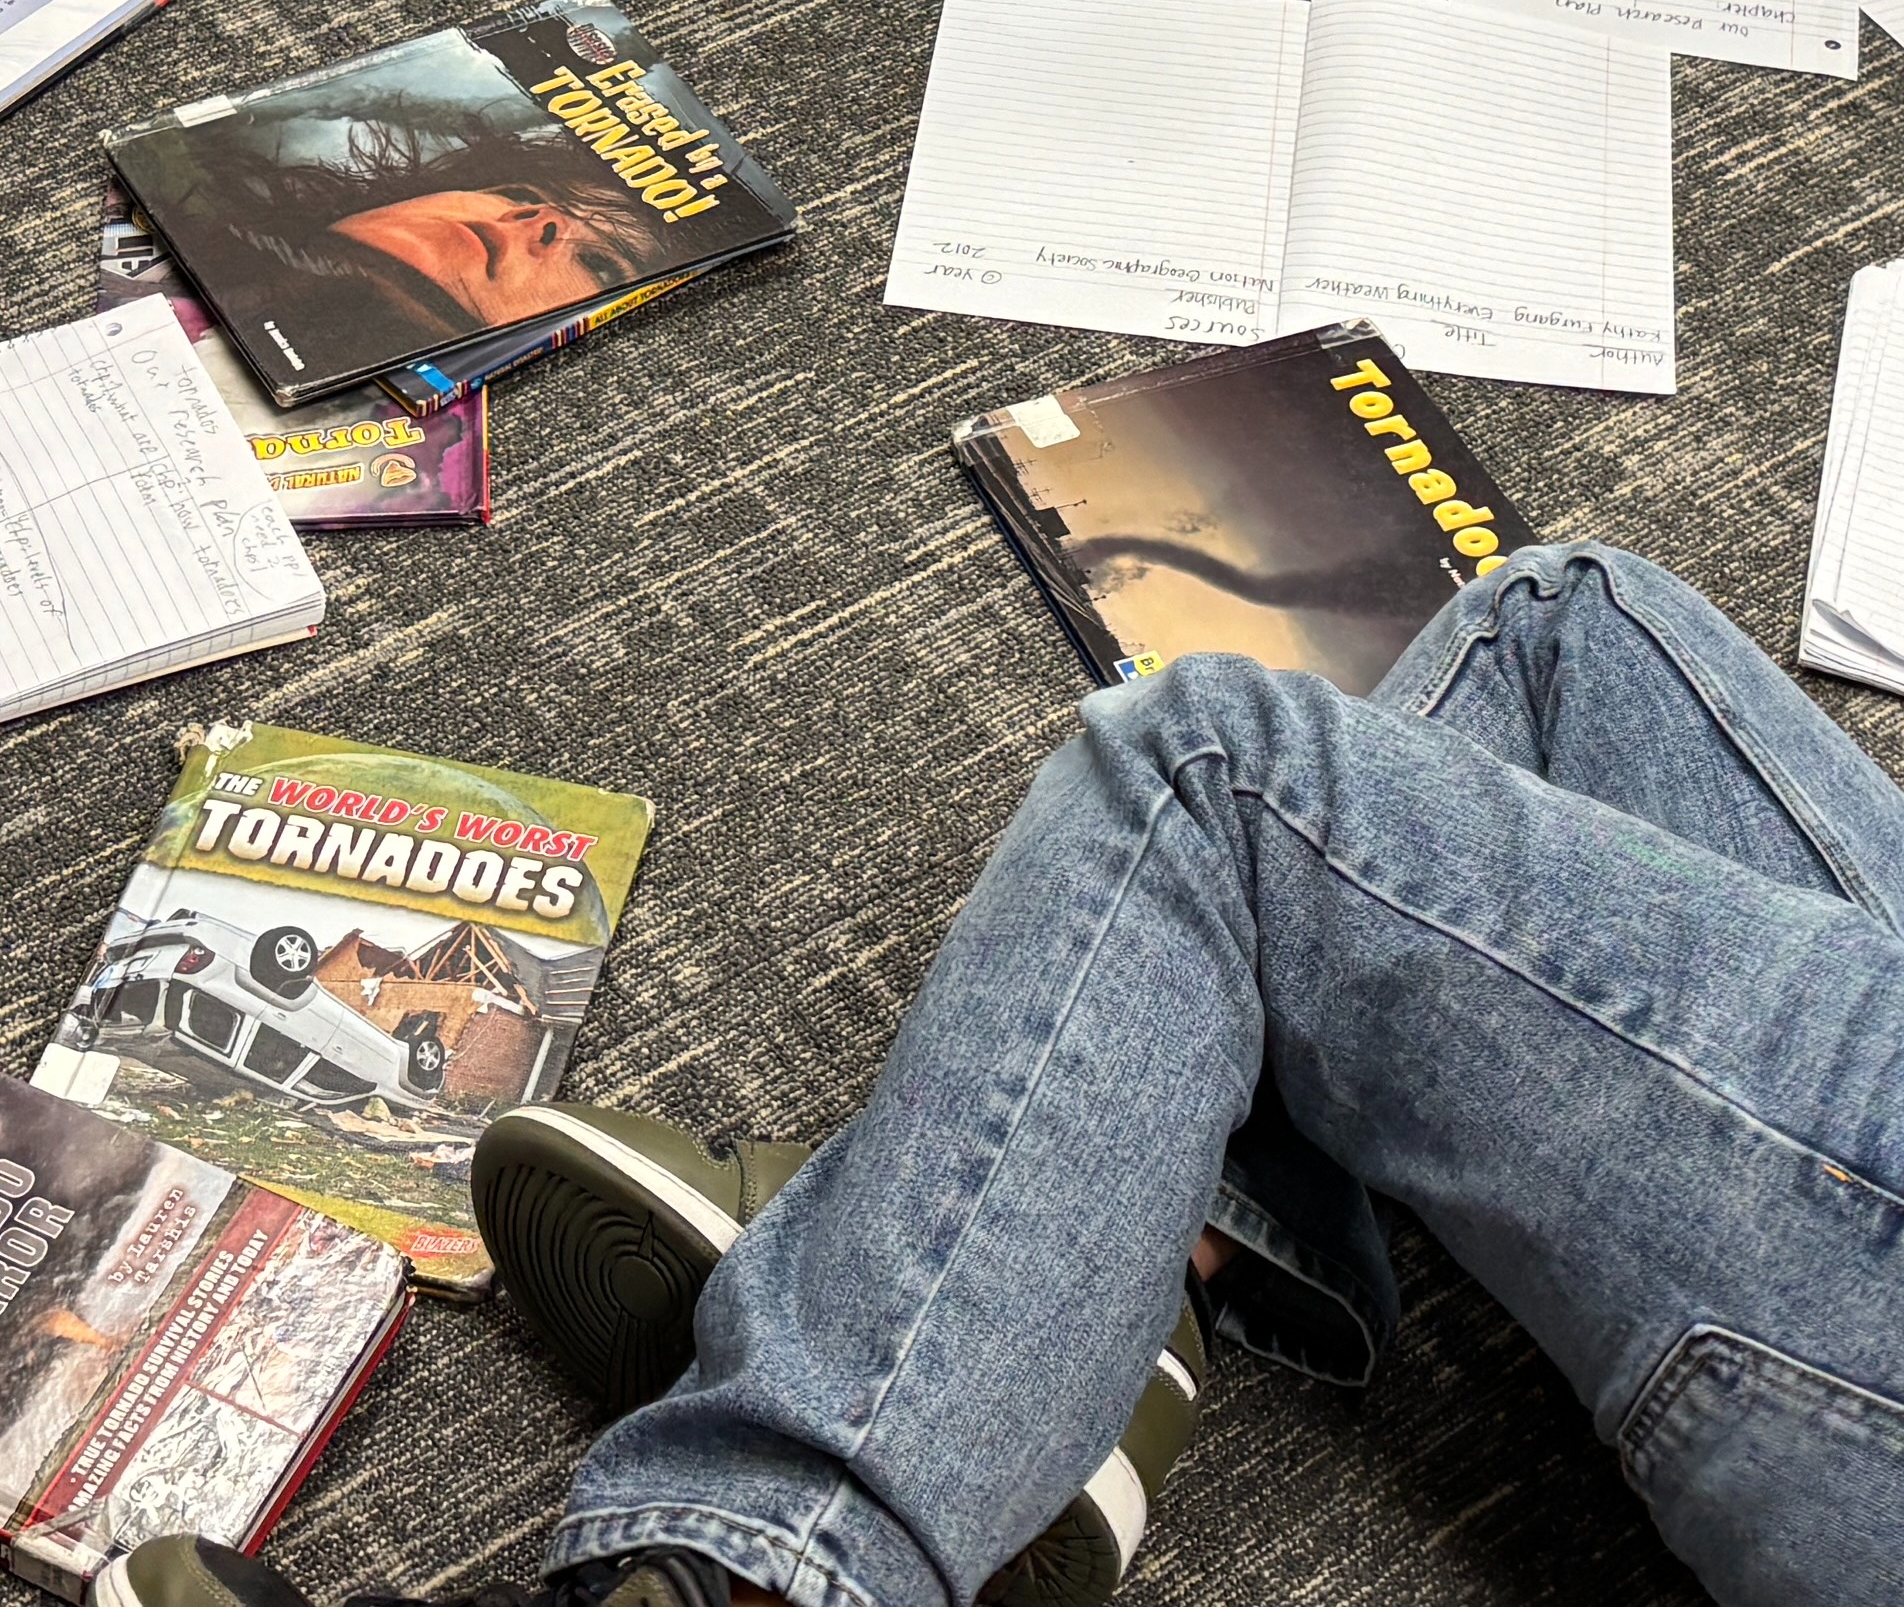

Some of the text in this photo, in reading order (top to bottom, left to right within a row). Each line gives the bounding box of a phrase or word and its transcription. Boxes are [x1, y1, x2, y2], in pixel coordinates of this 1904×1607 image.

[585, 59, 710, 152] Erased
[531, 66, 722, 223] TORNADO!
[688, 142, 725, 171] by
[700, 170, 728, 191] a
[932, 242, 985, 258] 2012
[1166, 288, 1255, 314] Publisher
[1443, 323, 1663, 365] Author Title
[251, 417, 423, 460] Torna
[285, 465, 362, 491] NATURAL
[200, 499, 242, 537] plan
[214, 777, 598, 862] THE WORLD'S WORST
[195, 798, 584, 919] TORNADOES
[108, 1186, 186, 1287] by Lauren
[134, 1203, 199, 1284] Tarshis
[411, 1227, 480, 1262] BLAZERS
[107, 1399, 155, 1453] FACTS
[139, 1359, 182, 1407] FROM
[164, 1298, 225, 1368] HISTORY
[208, 1268, 244, 1307] AND
[228, 1226, 274, 1277] TODAY
[68, 1247, 242, 1481] TRUE TORNADO SURVIVAL STORIES
